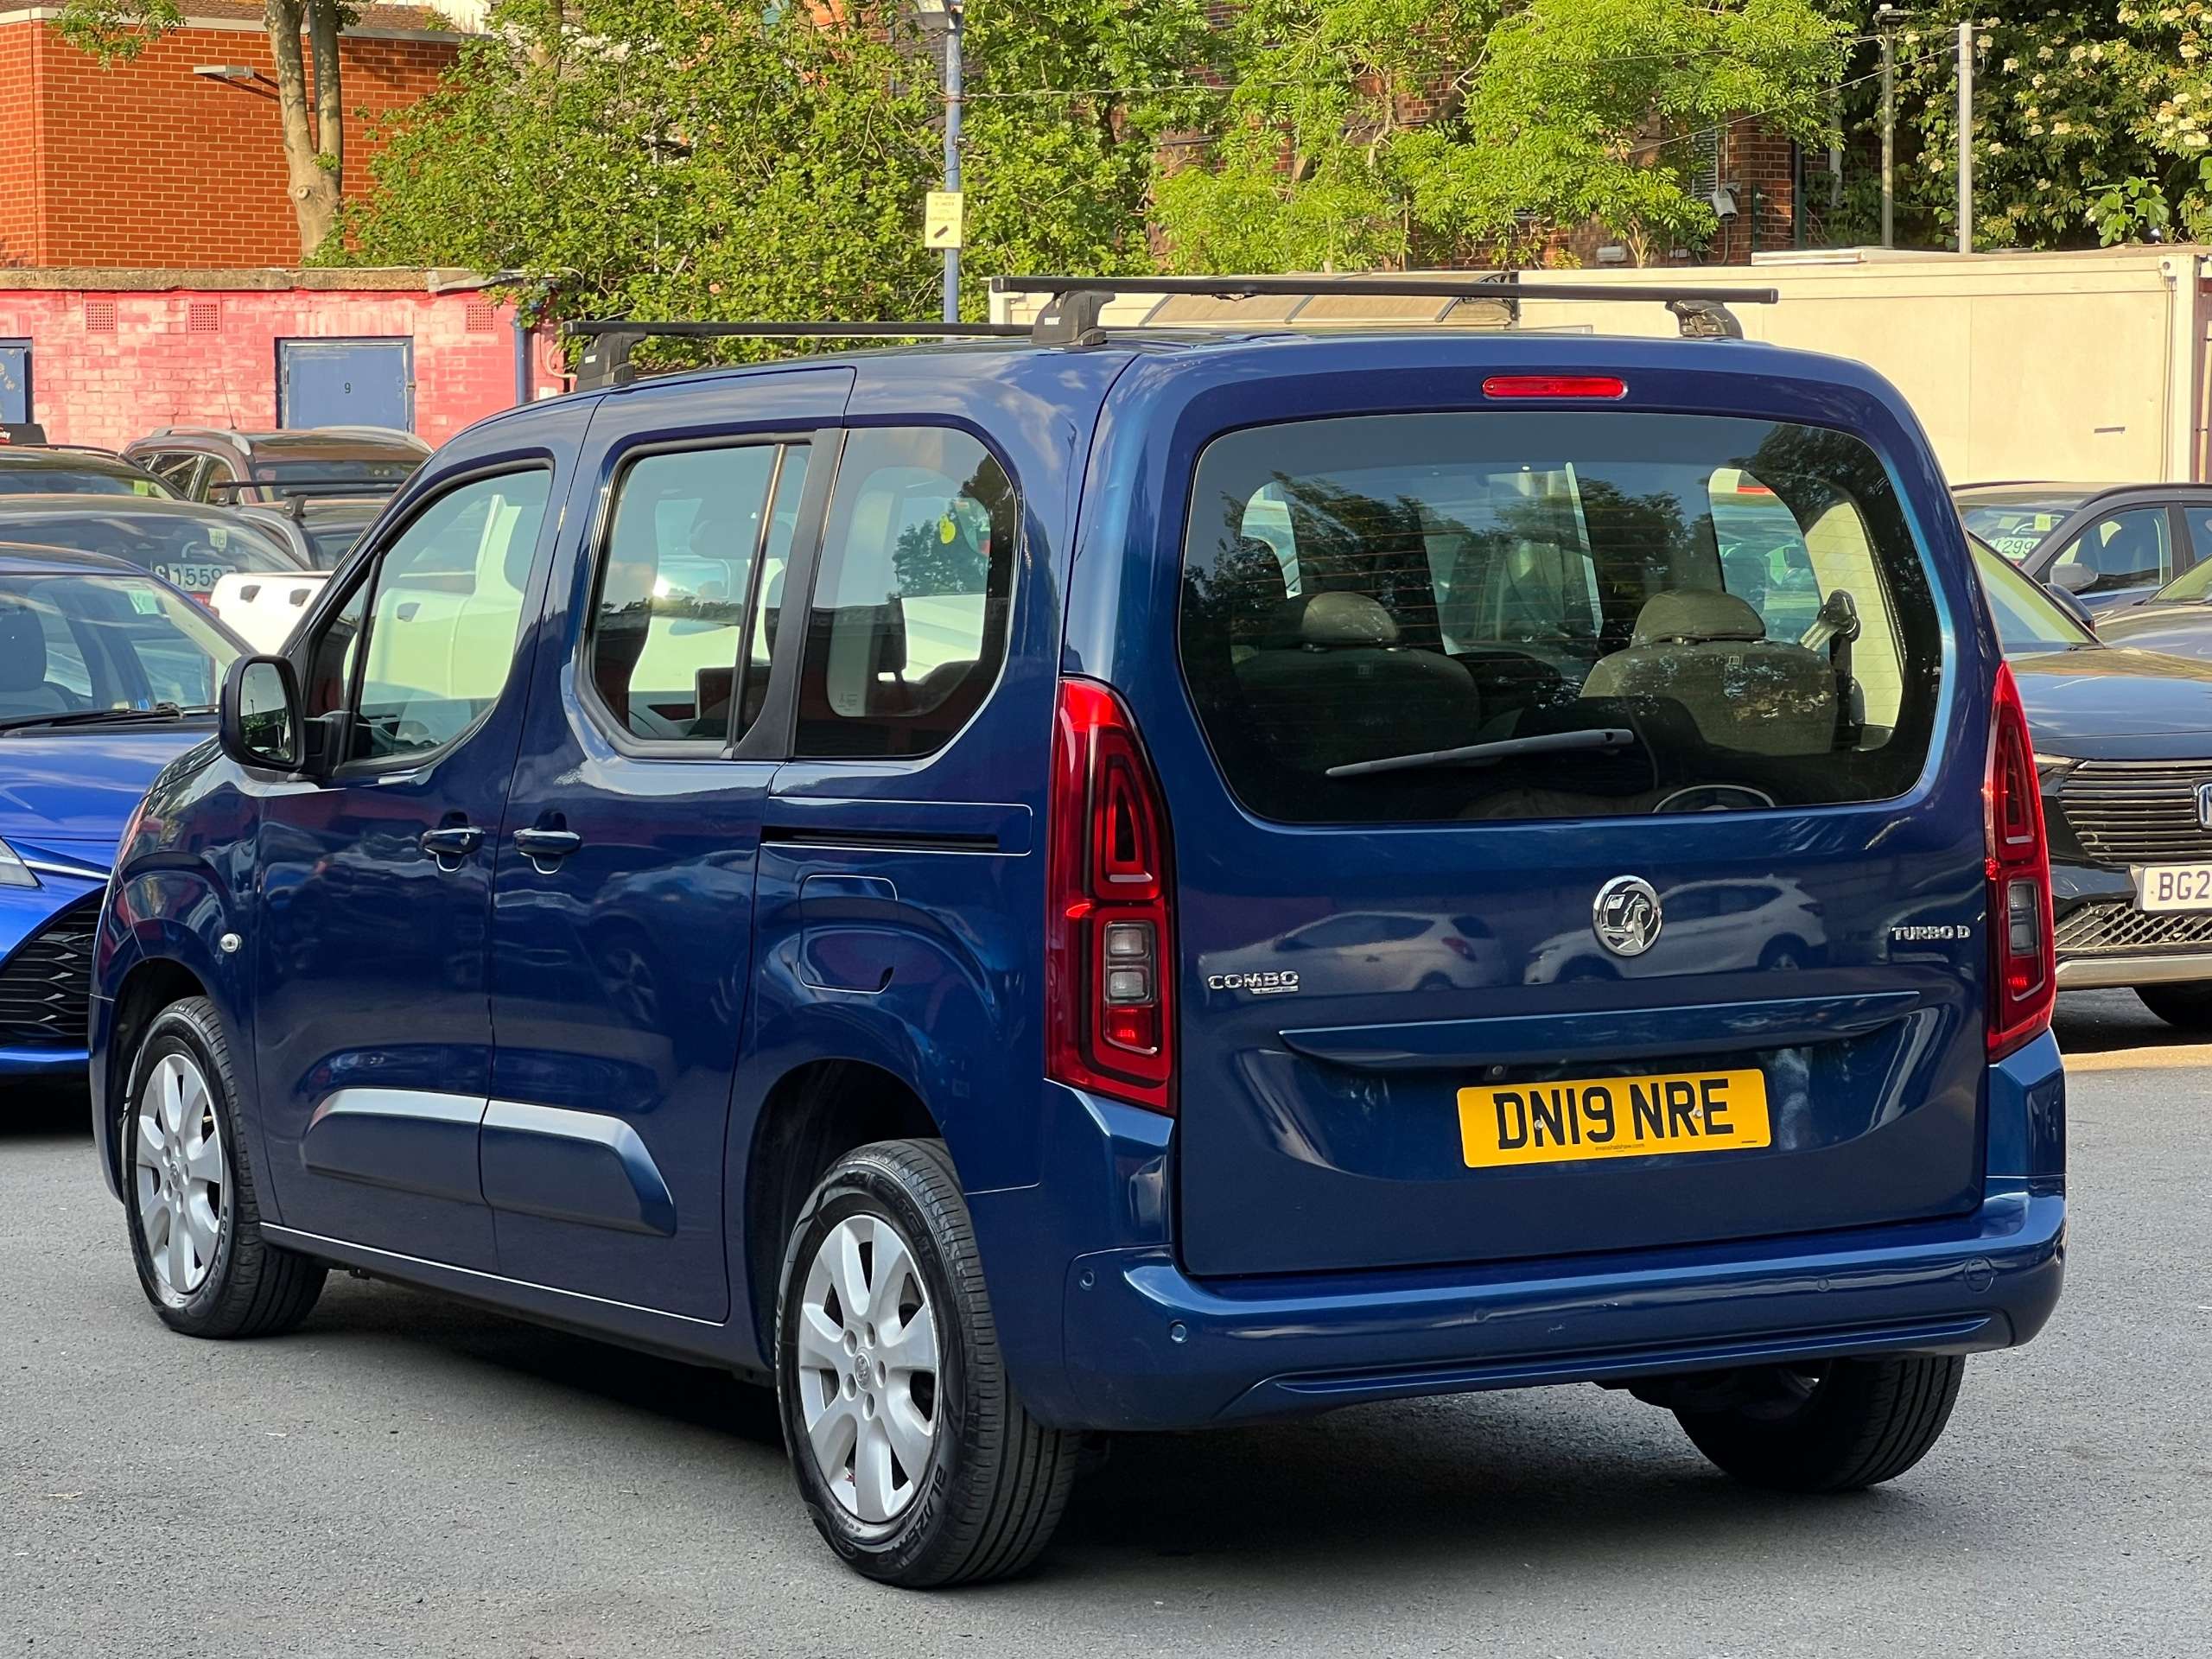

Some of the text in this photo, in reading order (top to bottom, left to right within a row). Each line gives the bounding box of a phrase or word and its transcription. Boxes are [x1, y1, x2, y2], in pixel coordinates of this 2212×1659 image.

[344, 382, 351, 394] 9
[2158, 870, 2211, 901] BG2
[1891, 925, 1971, 941] TURBO D
[1208, 970, 1299, 989] COMBO
[1492, 1077, 1735, 1150] DN19 NRE
